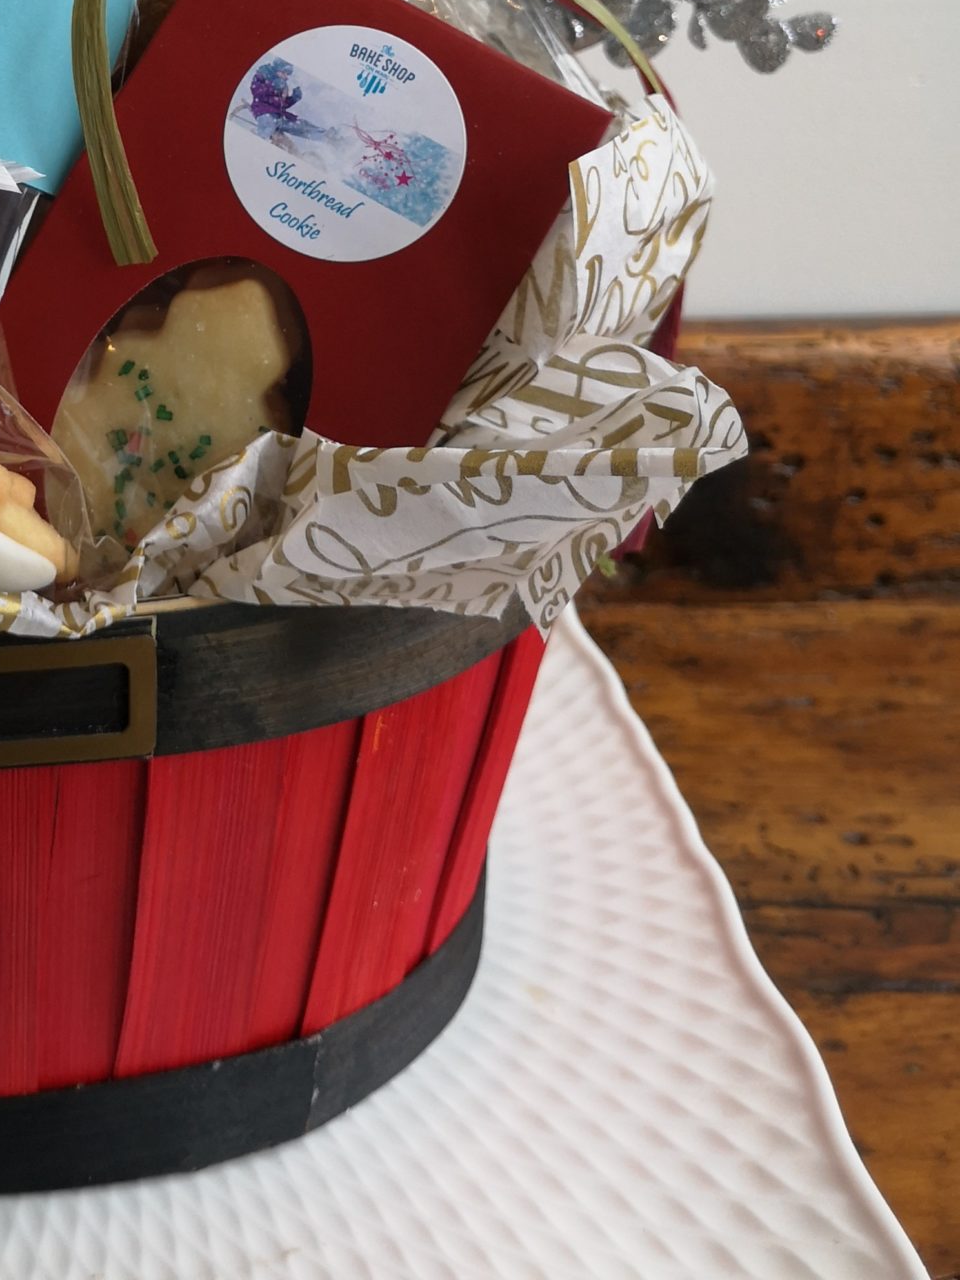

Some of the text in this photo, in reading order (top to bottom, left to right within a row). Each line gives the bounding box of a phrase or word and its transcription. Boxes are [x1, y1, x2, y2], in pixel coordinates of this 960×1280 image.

[349, 43, 416, 84] BAKE SHOP
[266, 161, 365, 218] Shortbread
[269, 202, 321, 240] Cookie
